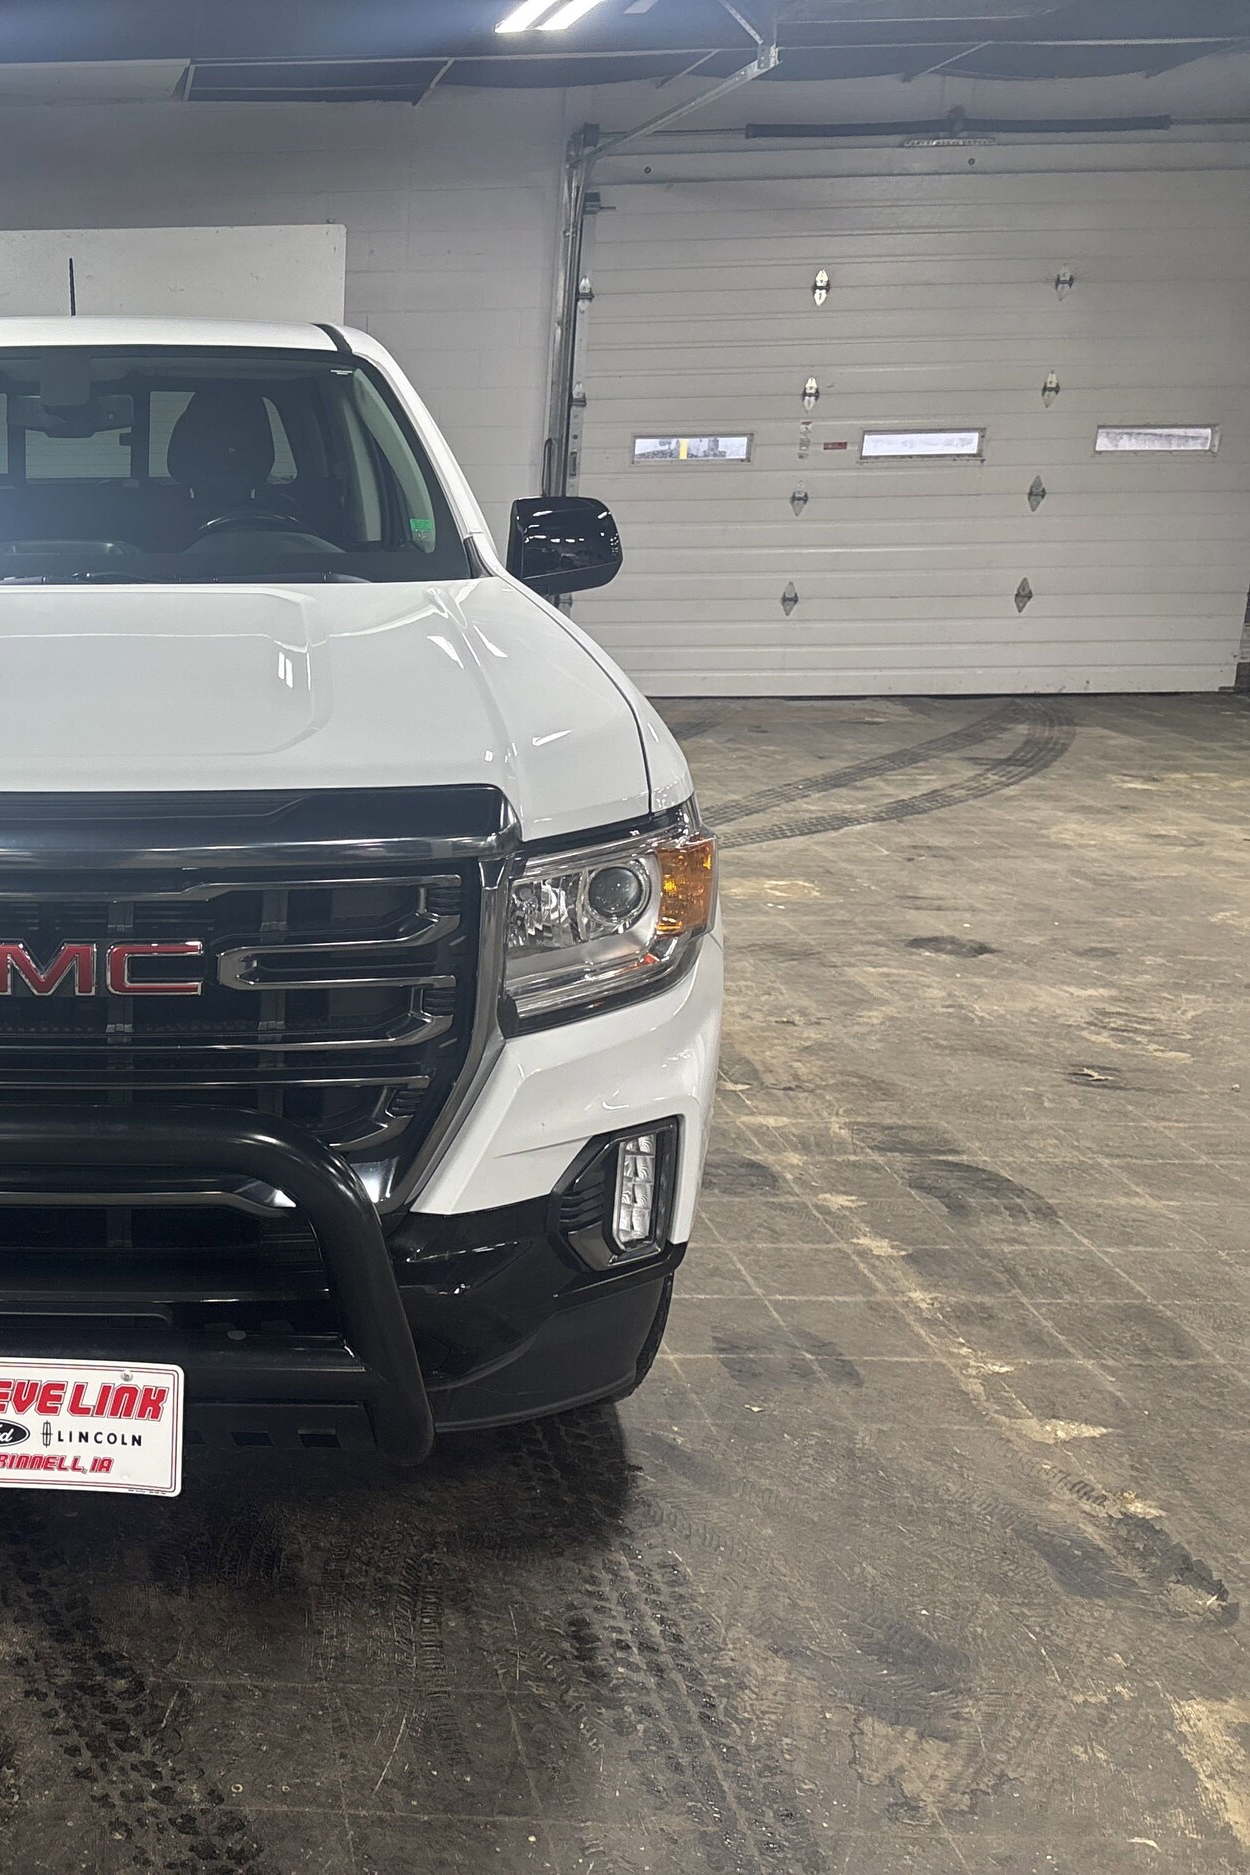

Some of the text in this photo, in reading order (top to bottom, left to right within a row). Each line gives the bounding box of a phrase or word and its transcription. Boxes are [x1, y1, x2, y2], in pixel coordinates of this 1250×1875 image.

[67, 1382, 170, 1422] LINK
[57, 1430, 143, 1447] LINCOLN
[89, 1456, 115, 1474] IA
